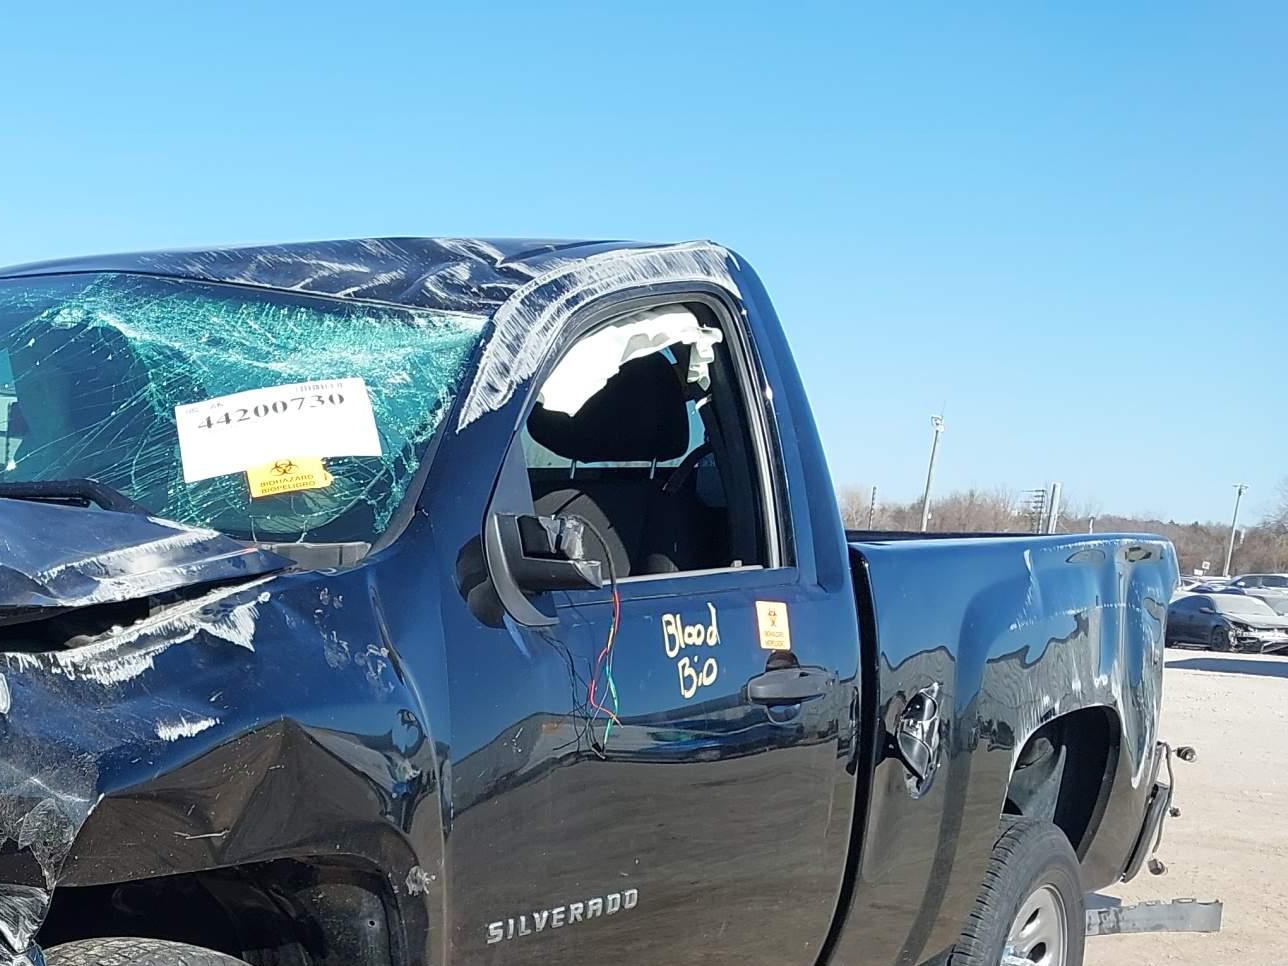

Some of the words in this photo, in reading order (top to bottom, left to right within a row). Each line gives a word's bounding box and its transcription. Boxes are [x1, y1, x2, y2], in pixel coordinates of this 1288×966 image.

[197, 393, 345, 429] 44200730
[260, 474, 314, 488] BIOHAZARD
[261, 480, 316, 494] BIOPELIGRO
[661, 602, 721, 659] Blood
[486, 888, 639, 945] SILVERADO
